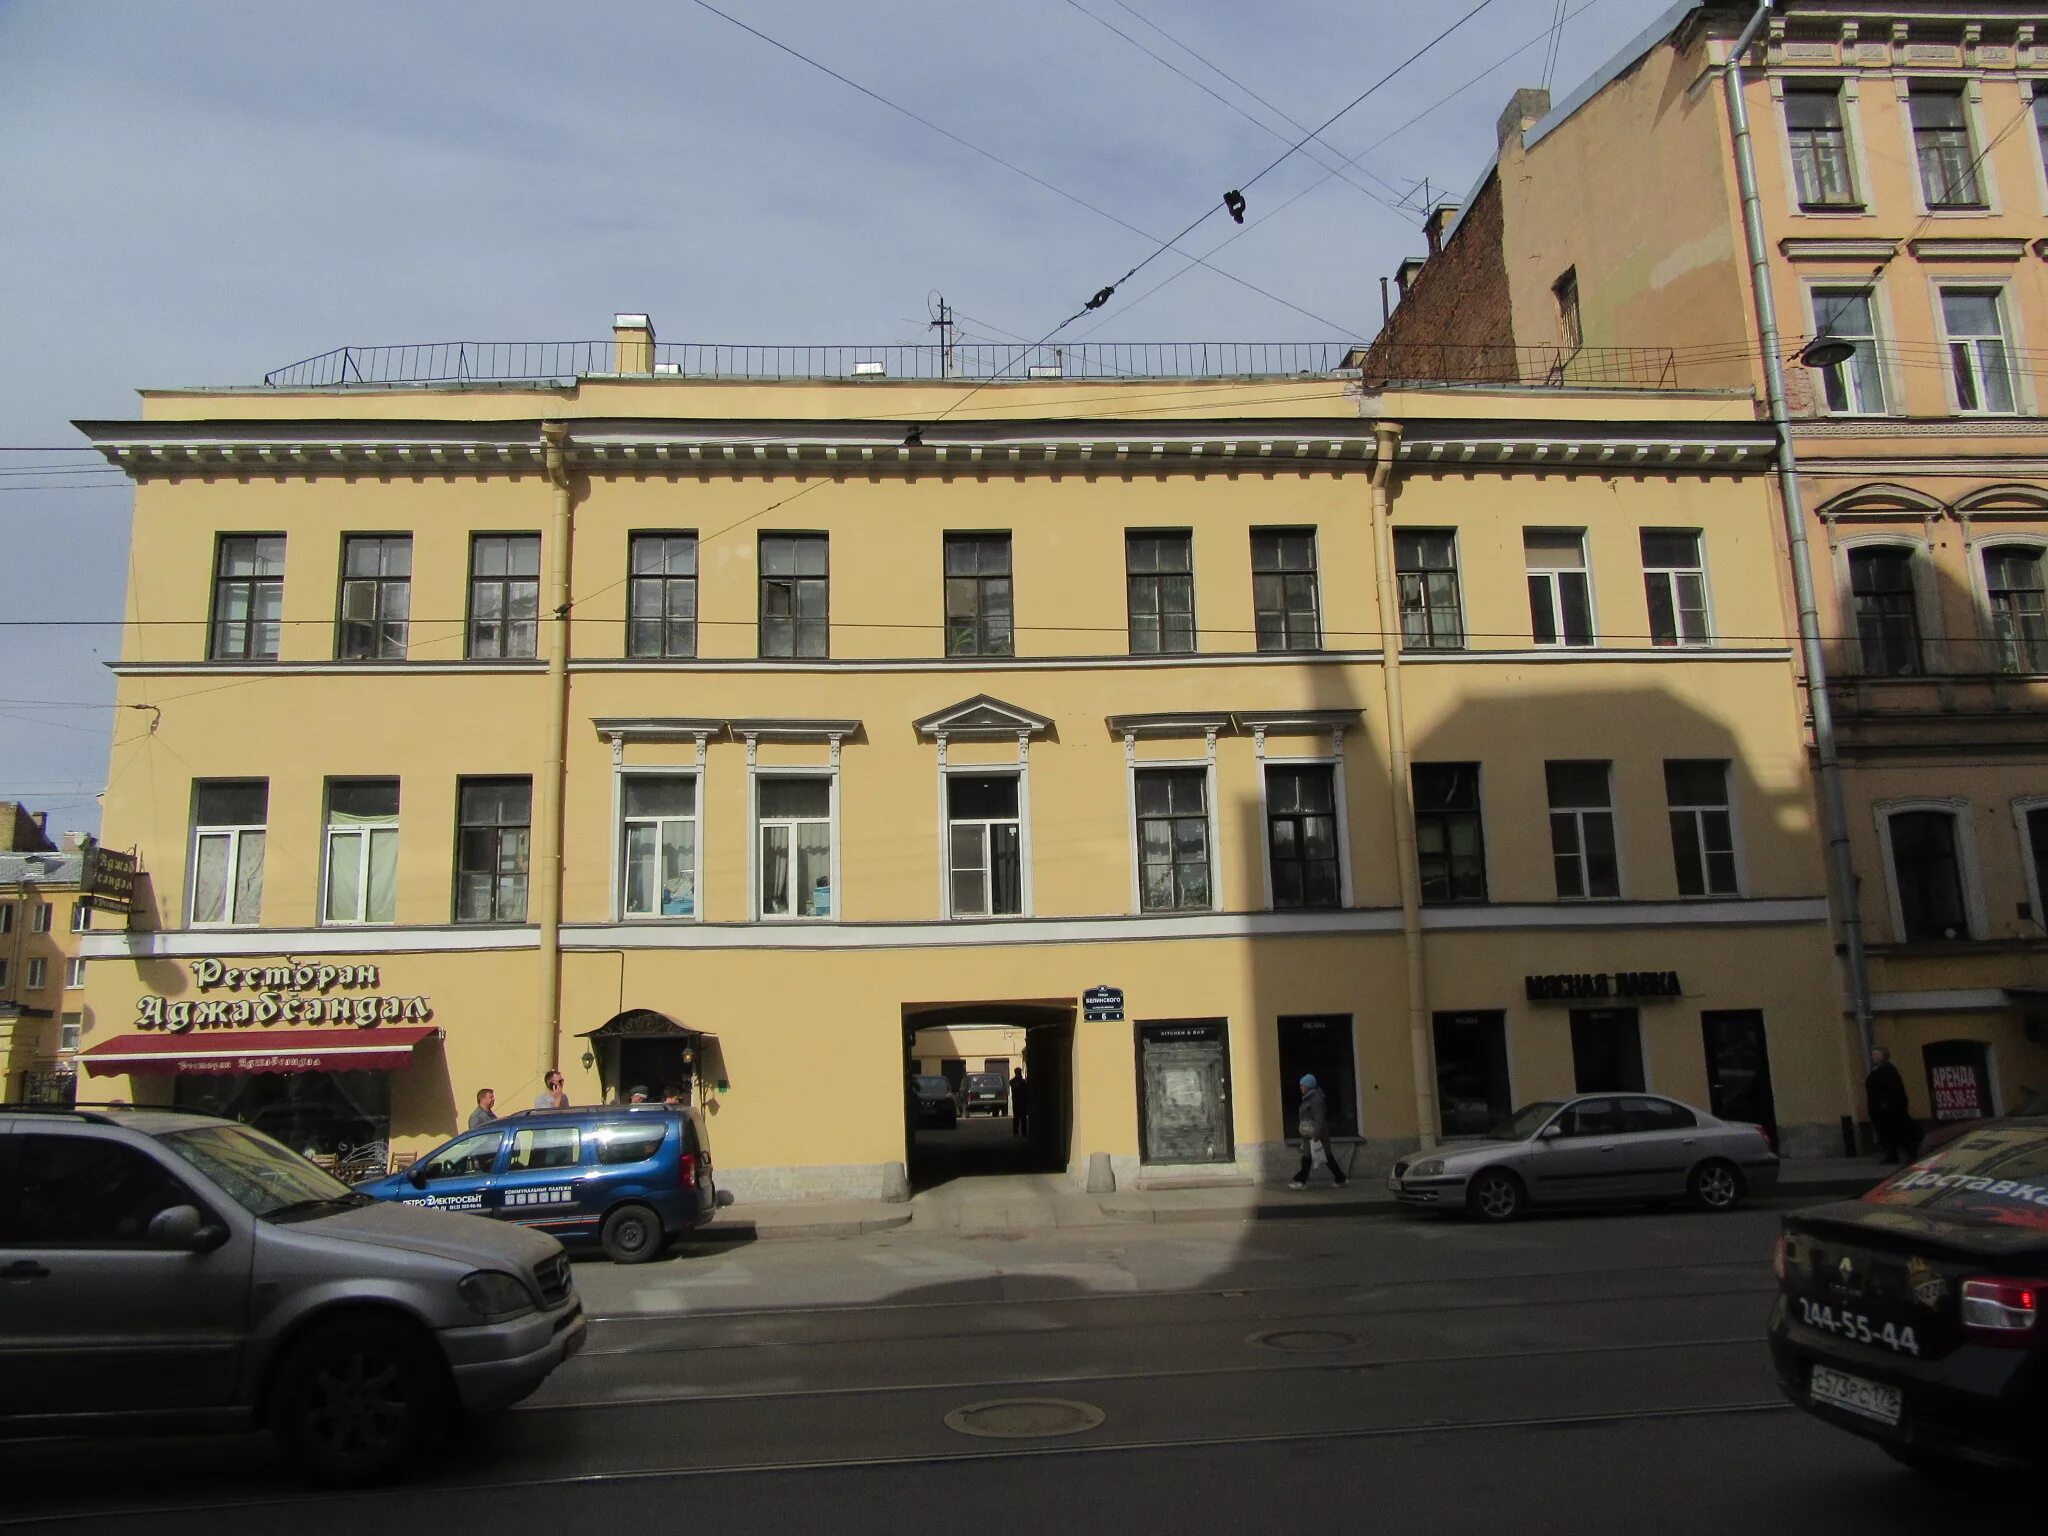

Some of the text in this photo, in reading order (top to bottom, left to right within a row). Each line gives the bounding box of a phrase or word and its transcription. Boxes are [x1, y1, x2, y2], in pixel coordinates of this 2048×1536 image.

[189, 957, 379, 993] Ресторан
[135, 991, 432, 1032] Аджабсандал
[1101, 1012, 1107, 1020] 6
[1932, 1066, 1976, 1088] АРЕНДА
[504, 1187, 547, 1195] КОММУНАЛЬНЫЕ
[1798, 1297, 1919, 1357] 244-55-44
